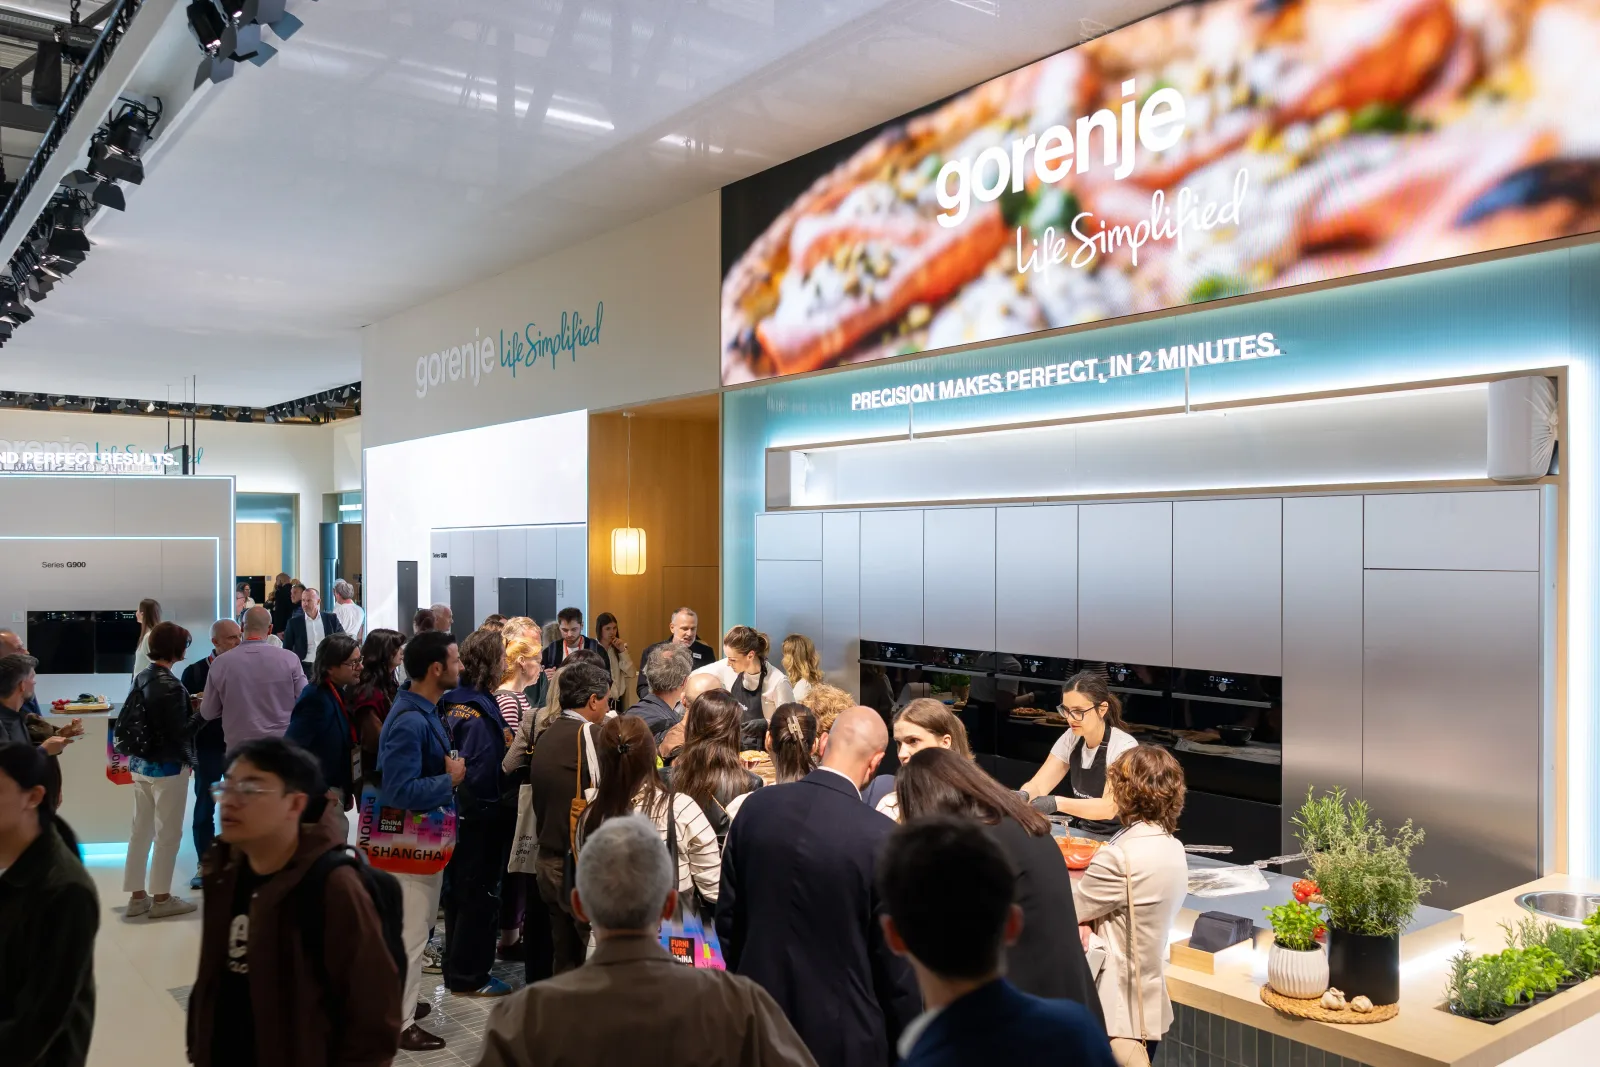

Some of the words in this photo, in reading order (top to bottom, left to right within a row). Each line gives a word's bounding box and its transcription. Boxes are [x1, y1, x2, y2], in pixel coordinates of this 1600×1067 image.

[935, 78, 1186, 229] gorenje
[1071, 168, 1249, 269] Simplified
[415, 327, 495, 399] gorenje
[525, 301, 604, 370] Simplified
[852, 382, 935, 410] PRECISION
[939, 373, 1003, 400] MAKES
[1007, 358, 1107, 391] PERFECT,
[1110, 353, 1132, 377] IN
[1139, 350, 1153, 373] 2
[1158, 332, 1281, 371] MINUTES.
[23, 452, 97, 466] PERFECT
[100, 452, 179, 466] RESULTS.
[671, 939, 689, 948] FURNI
